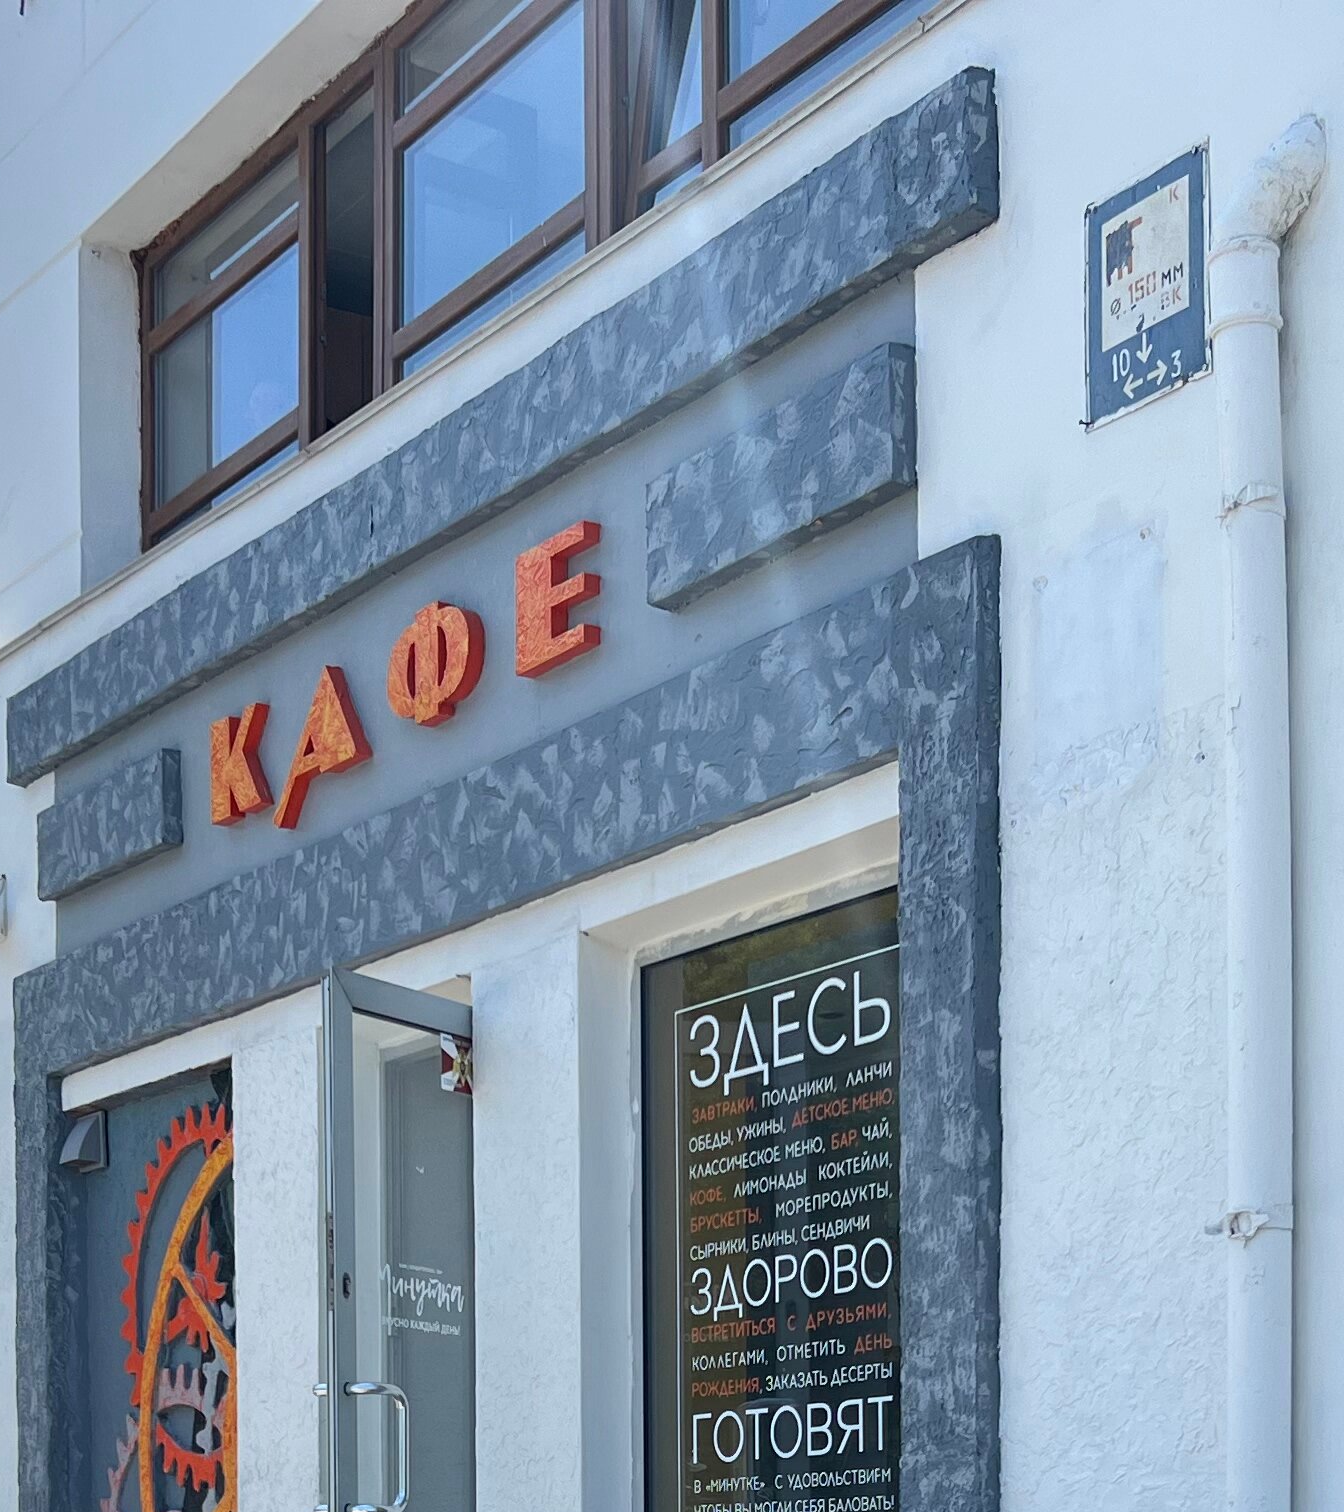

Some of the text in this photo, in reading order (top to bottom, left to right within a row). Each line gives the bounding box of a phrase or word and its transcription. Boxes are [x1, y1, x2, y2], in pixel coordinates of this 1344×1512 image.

[1128, 270, 1156, 305] 150
[1111, 348, 1130, 383] 10
[1171, 350, 1182, 378] 3
[209, 520, 601, 830] КАФЕ
[689, 971, 891, 1096] ЗДЕСЬ
[691, 1061, 892, 1124] ЗАВТРАКИ, ПОЛДНИКИ, ЛАНЧИ
[689, 1130, 734, 1153] ОБЕДЫ,
[736, 1117, 786, 1142] УЖИНЫ,
[791, 1098, 849, 1129] ДЕТСКОЕ
[689, 1147, 781, 1180] КЛАССИЧЕСКОЕ
[785, 1136, 825, 1159] МЕНЮ,
[861, 1117, 893, 1141] ЧАЙ,
[733, 1169, 807, 1198] ЛИМОНАДЫ
[818, 1151, 893, 1181] КОКТЕЙЛИ,
[690, 1181, 893, 1233] БРУСКЕТТЫ, МОРЕПРОДУКТЫ,
[690, 1214, 871, 1261] СЫРНИКИ, БЛИНЫ, СЕНДВИЧИ
[690, 1237, 893, 1321] ЗДОРОВО
[691, 1302, 892, 1343] ВСТРЕТИТЬСЯ С ДРУЗЬЯМИ,
[692, 1333, 893, 1371] КОЛЛЕГАМИ, ОТМЕТИТЬ ДЕНЬ
[691, 1362, 893, 1397] РОЖДЕНИЯ, ЗАКАЗАТЬ ДЕСЕРТЫ
[692, 1395, 894, 1464] ГОТОВЯТ
[694, 1479, 701, 1494] В
[706, 1476, 765, 1492] «МИНУТКЕ»
[774, 1474, 783, 1490] С
